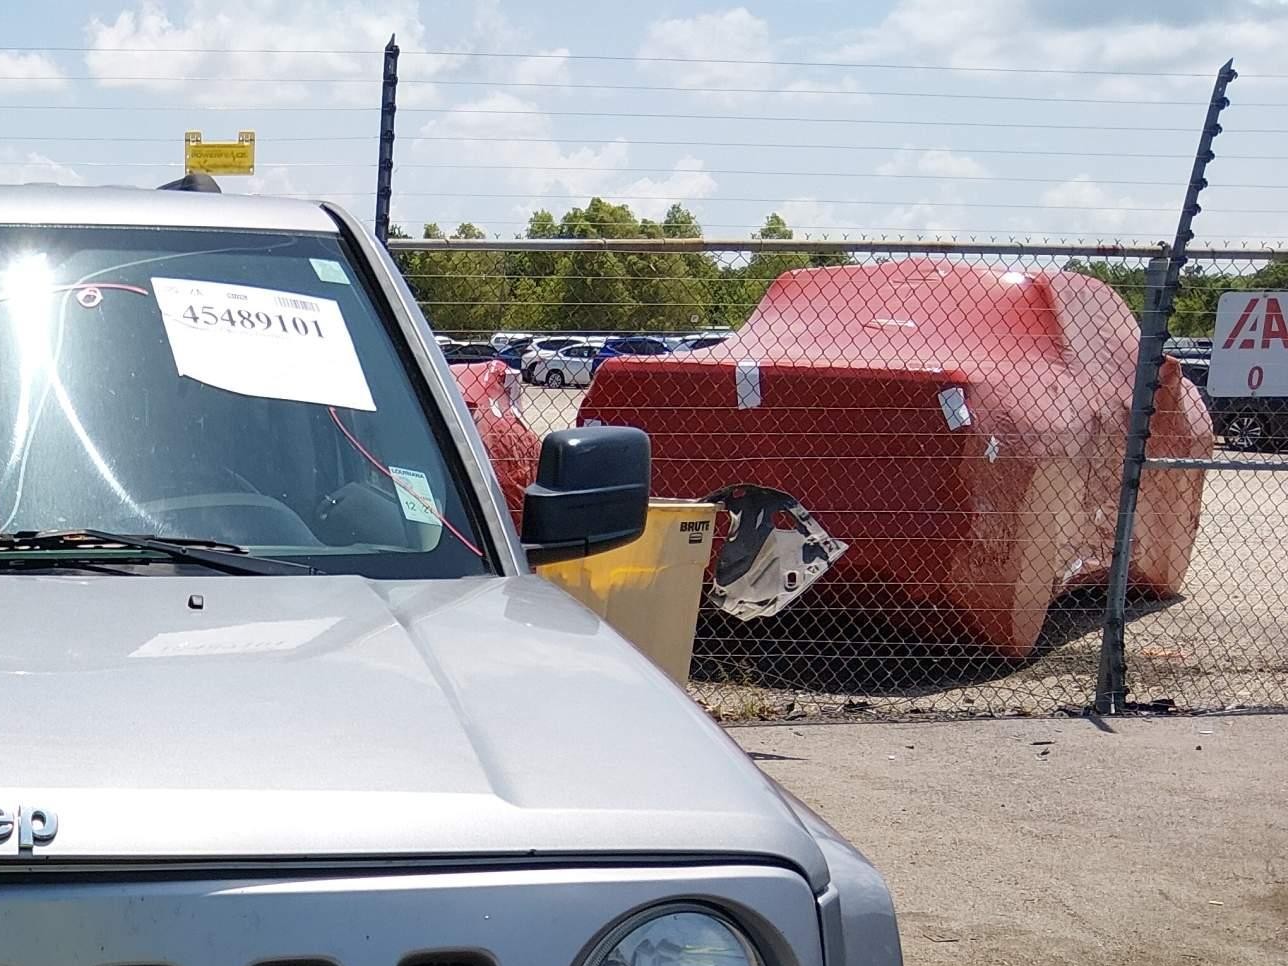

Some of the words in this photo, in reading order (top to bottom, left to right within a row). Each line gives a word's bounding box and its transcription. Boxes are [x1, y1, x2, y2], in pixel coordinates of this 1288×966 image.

[182, 304, 325, 338] 45489101
[1247, 365, 1264, 390] 0
[679, 520, 710, 532] BRUTE
